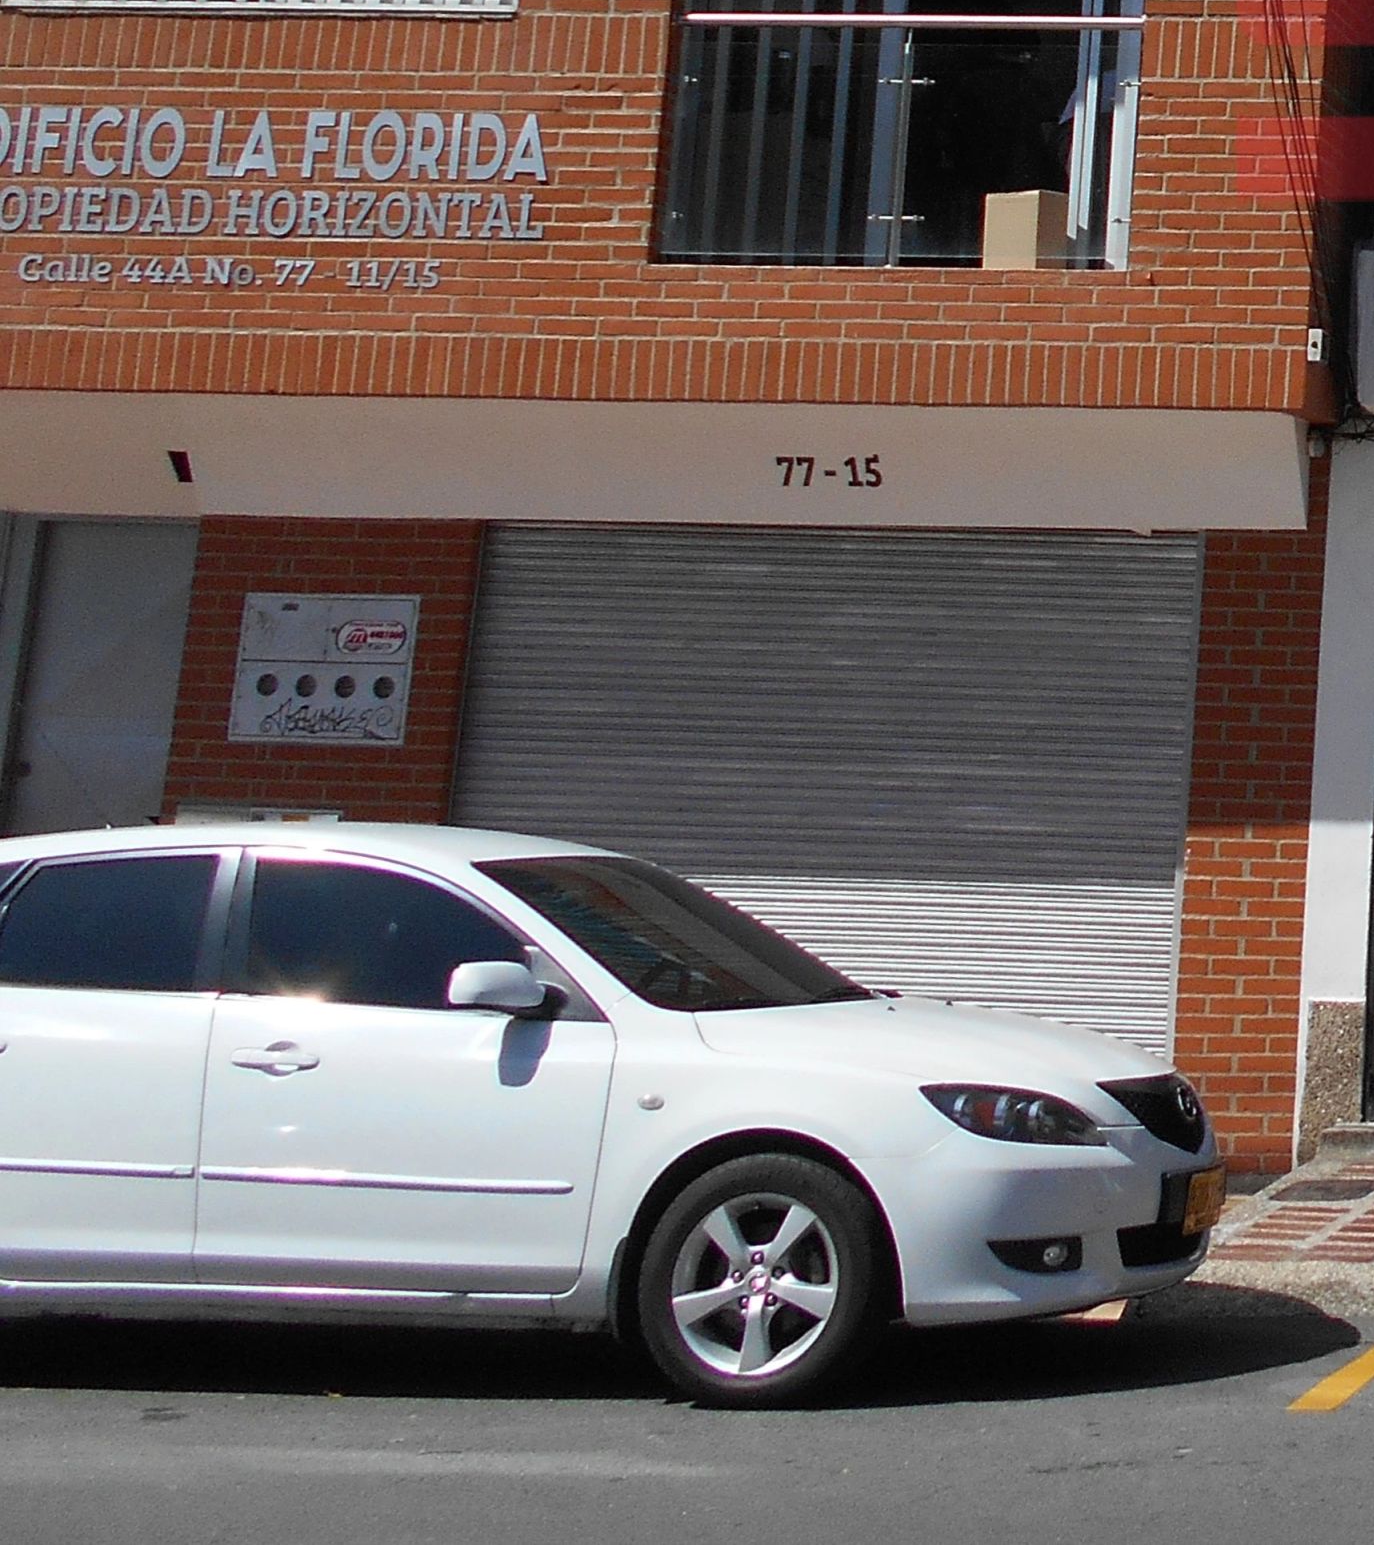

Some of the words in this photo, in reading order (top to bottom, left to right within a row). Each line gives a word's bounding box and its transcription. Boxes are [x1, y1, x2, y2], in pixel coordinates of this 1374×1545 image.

[206, 109, 278, 179] LA
[300, 110, 549, 183] FLORIDA
[223, 188, 543, 240] HORIZONTAL
[18, 253, 112, 284] Calle
[121, 255, 194, 285] 44A
[203, 256, 263, 287] No.
